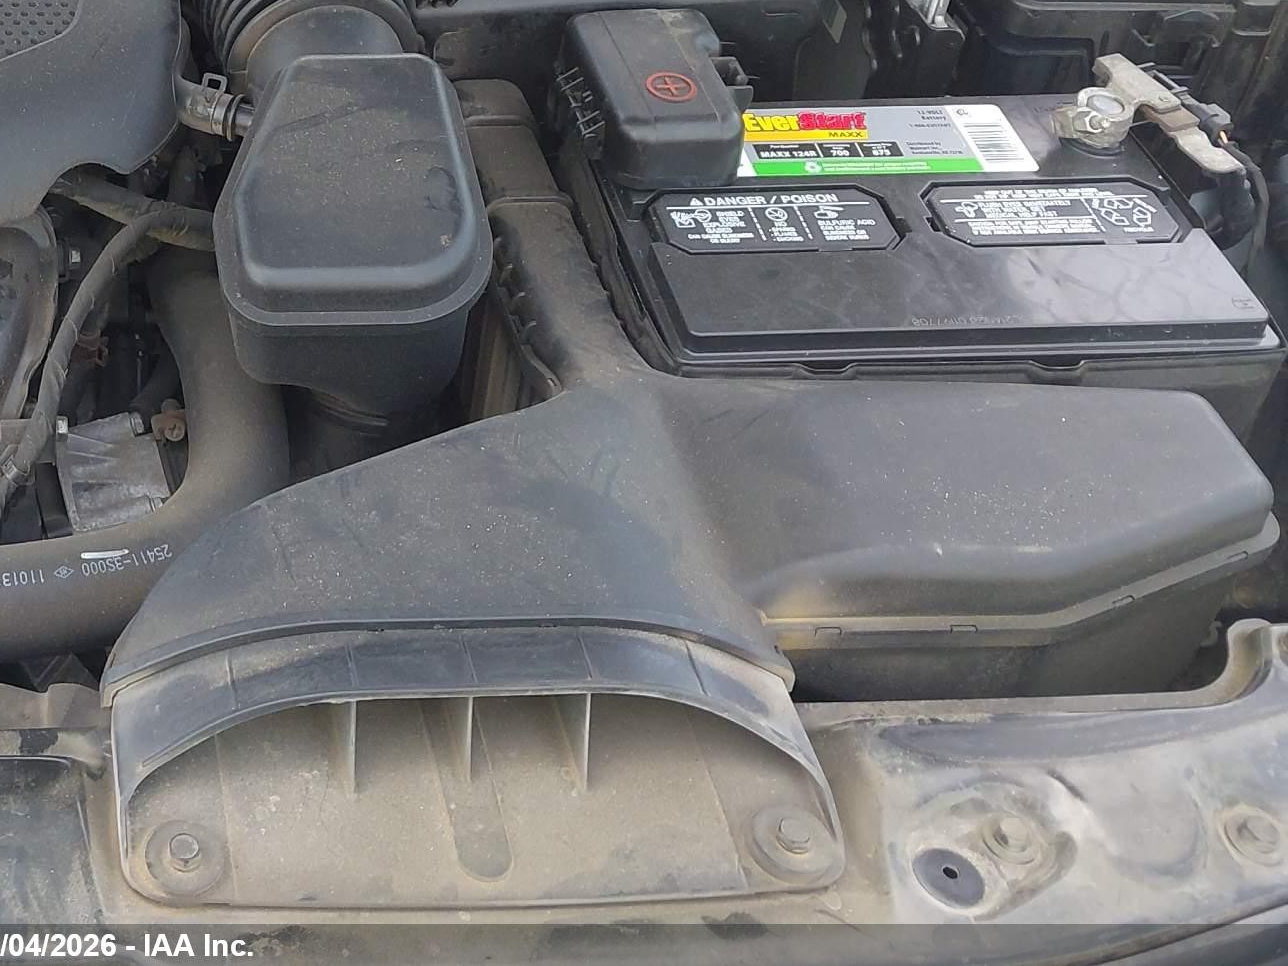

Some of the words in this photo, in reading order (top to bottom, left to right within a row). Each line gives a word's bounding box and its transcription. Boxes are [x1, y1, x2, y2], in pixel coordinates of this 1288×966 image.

[742, 112, 867, 131] EverStart
[759, 150, 791, 158] MAXX
[703, 196, 767, 206] DANGER
[780, 193, 839, 203] POISON
[81, 544, 172, 576] 25411-3S000
